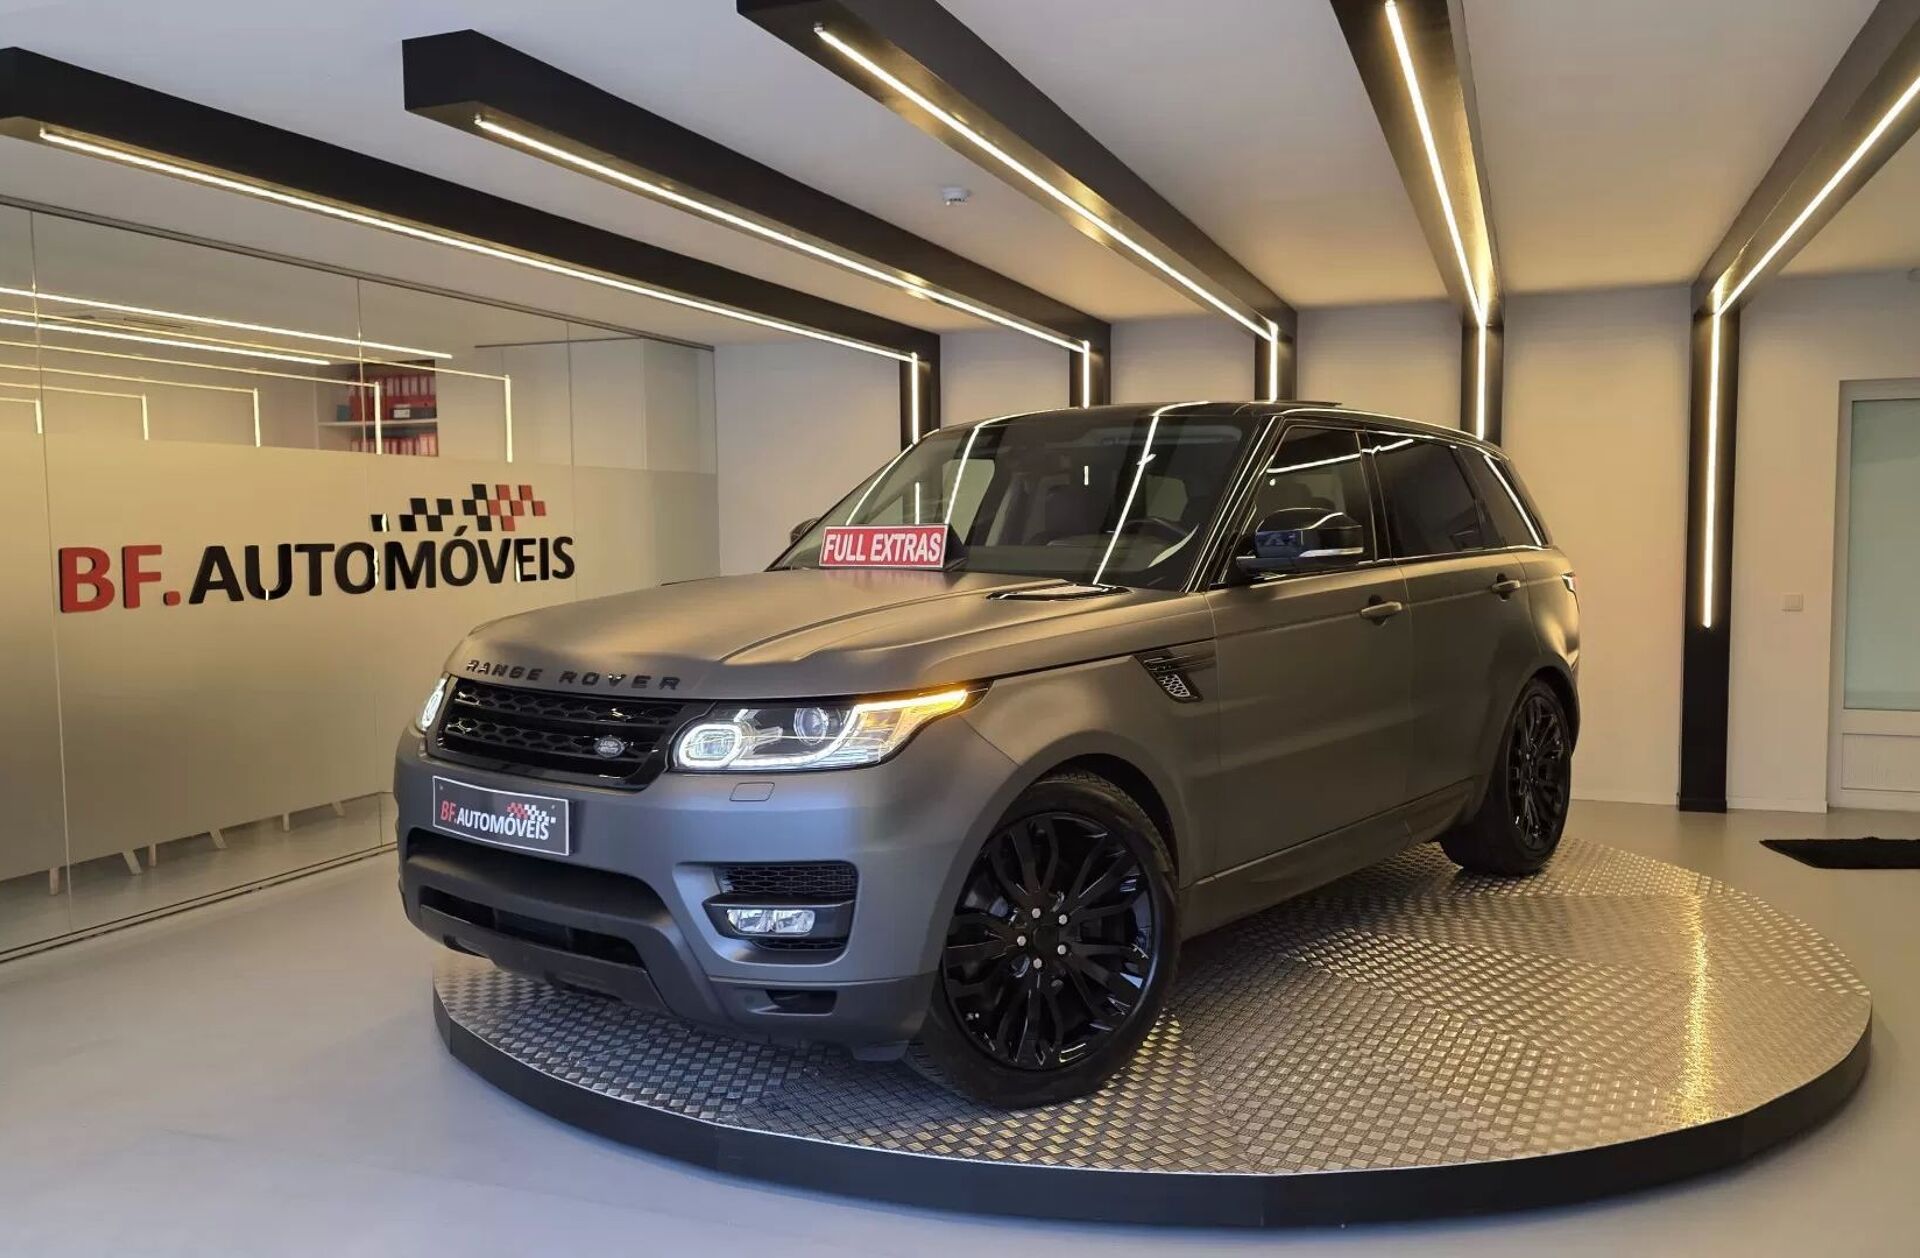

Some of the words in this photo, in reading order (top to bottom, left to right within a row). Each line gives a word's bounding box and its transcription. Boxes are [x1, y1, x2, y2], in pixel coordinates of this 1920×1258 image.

[823, 534, 867, 561] FULL
[870, 533, 941, 562] EXTRAS
[59, 525, 576, 613] BF.AUTOMÓVEIS
[466, 659, 543, 681] RANGE
[559, 671, 681, 690] ROVER
